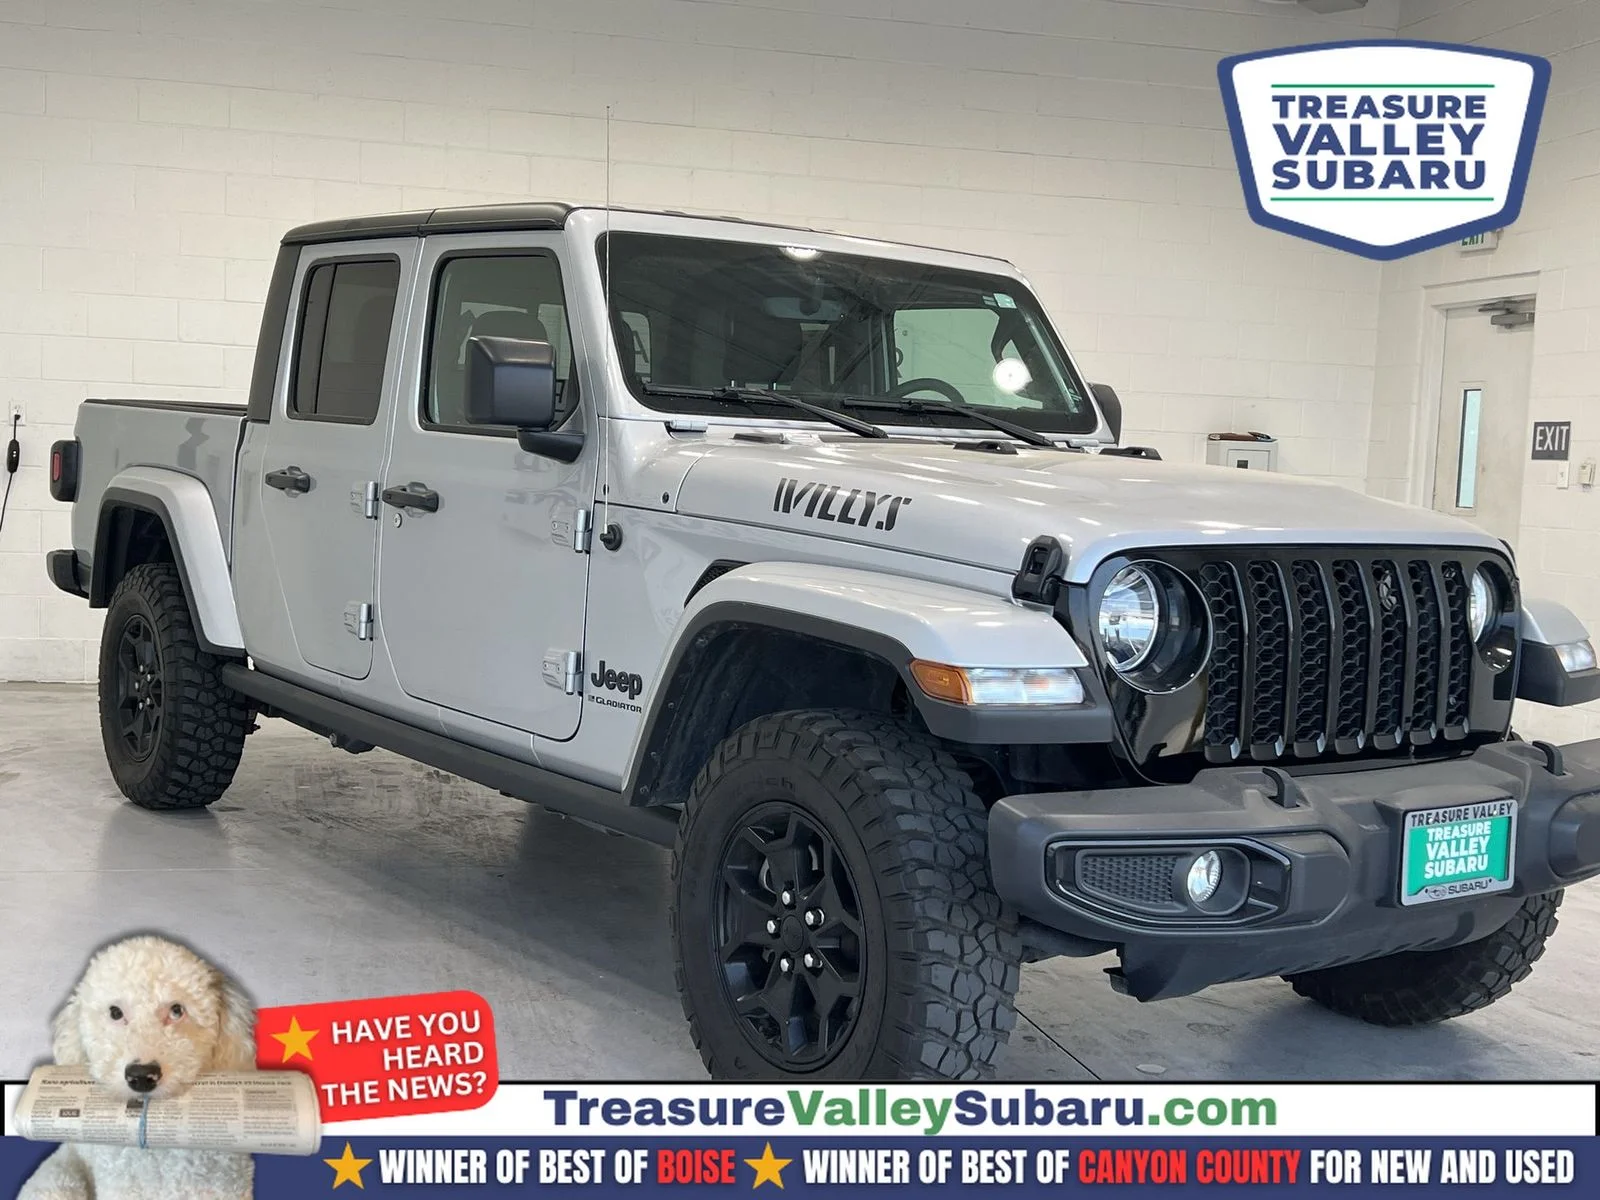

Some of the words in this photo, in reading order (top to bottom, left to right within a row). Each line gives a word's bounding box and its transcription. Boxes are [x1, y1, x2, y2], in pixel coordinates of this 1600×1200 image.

[1535, 426, 1569, 451] EXIT
[773, 478, 912, 531] WILLYS
[591, 660, 643, 700] Jeep
[595, 697, 642, 714] GLADIATOR
[1411, 808, 1469, 828] TREASURE
[1473, 802, 1513, 818] VALLEY
[1427, 821, 1491, 842] TREASURE
[1426, 836, 1490, 860] VALLEY
[1424, 854, 1488, 879] SUBARU
[1448, 880, 1488, 894] SUBARU
